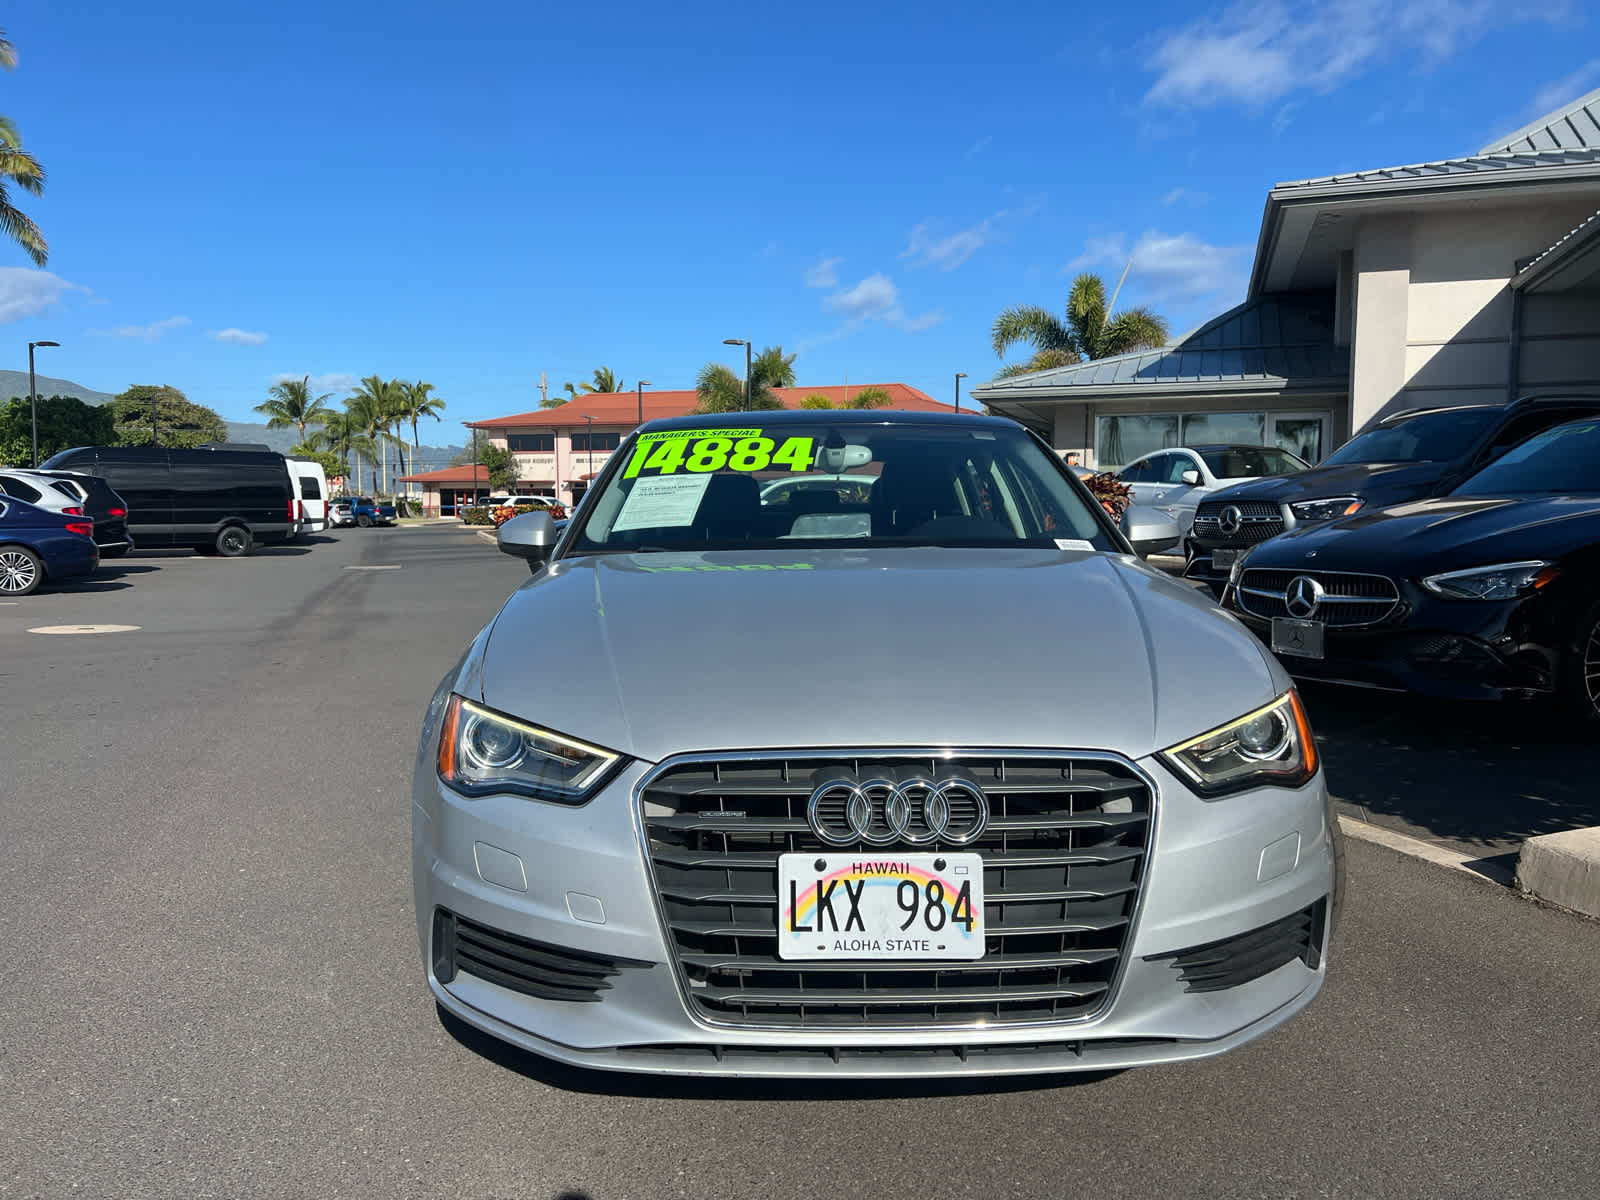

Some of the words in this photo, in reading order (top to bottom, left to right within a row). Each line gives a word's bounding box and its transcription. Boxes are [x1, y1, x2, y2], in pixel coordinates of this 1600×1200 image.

[642, 430, 707, 441] MANAGER'S
[711, 429, 757, 438] SPECIAL
[623, 437, 814, 479] 14884
[852, 862, 910, 874] HAWAII
[790, 880, 865, 932] LKX
[896, 880, 974, 932] 984
[833, 939, 881, 951] ALOHA
[886, 939, 930, 951] STATE
